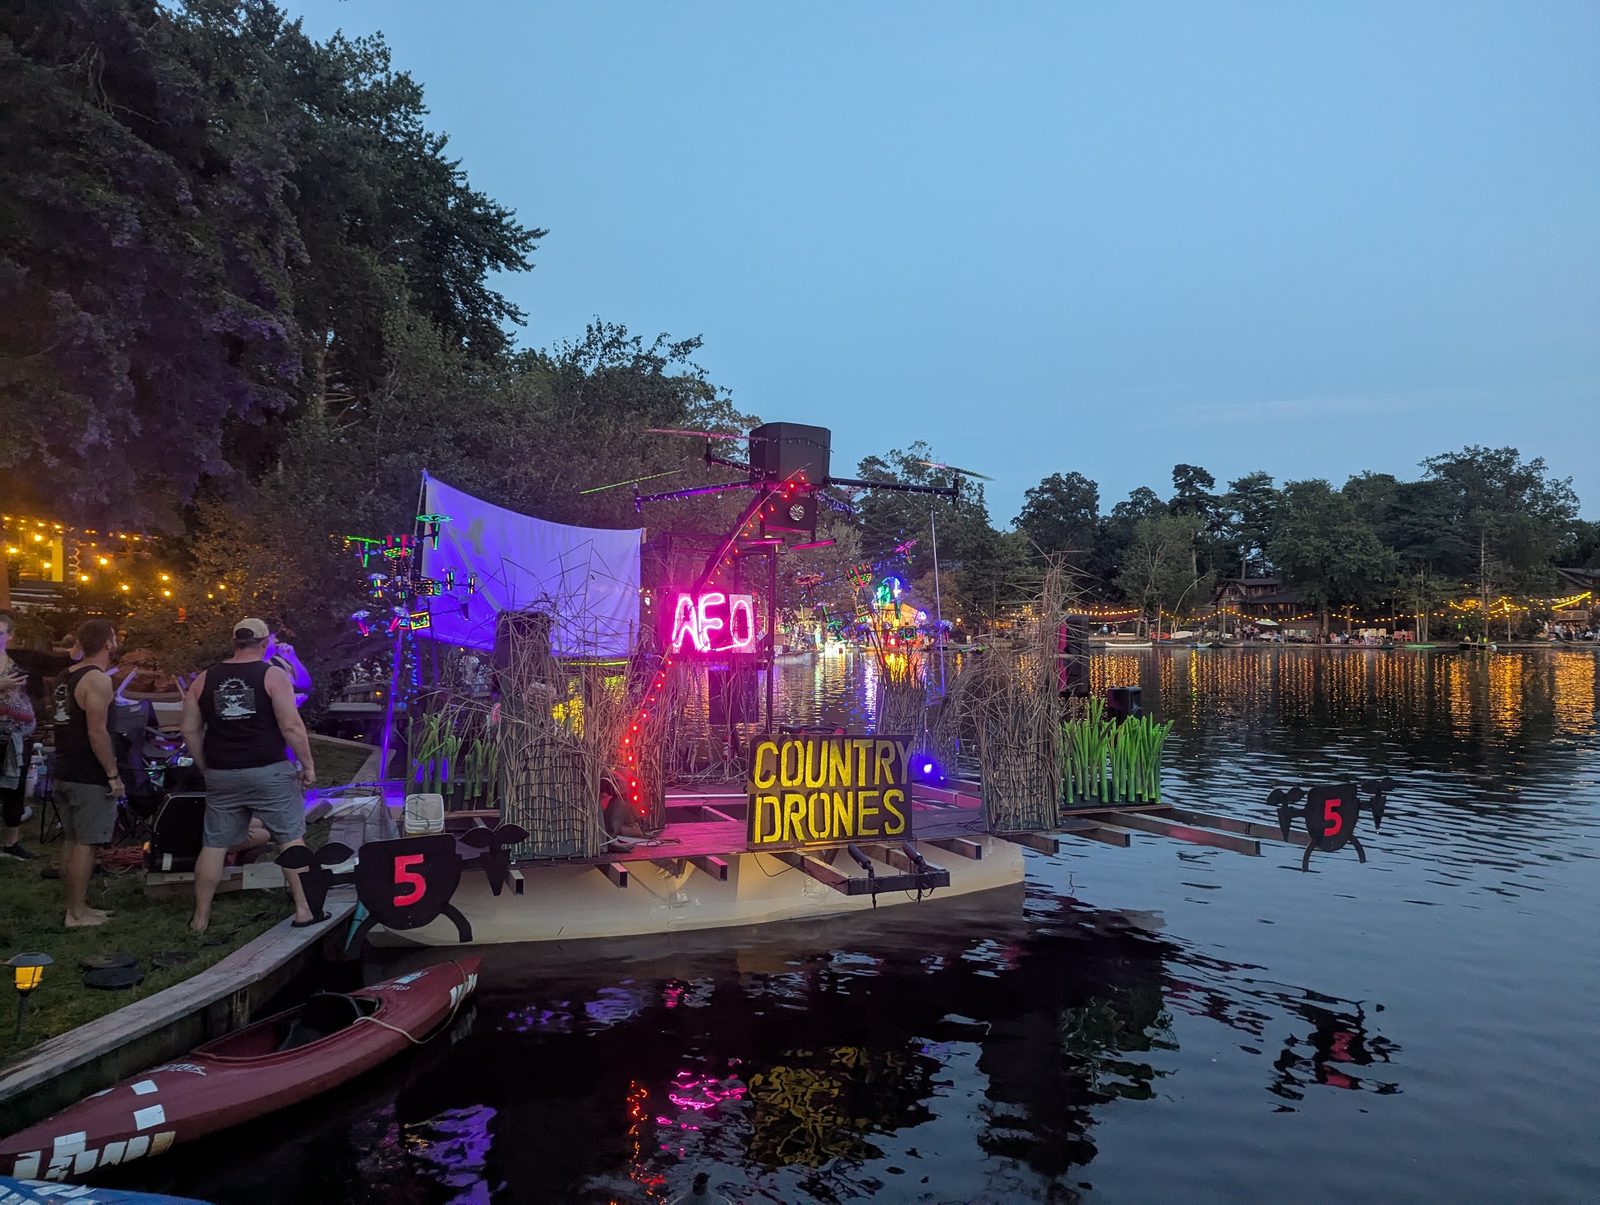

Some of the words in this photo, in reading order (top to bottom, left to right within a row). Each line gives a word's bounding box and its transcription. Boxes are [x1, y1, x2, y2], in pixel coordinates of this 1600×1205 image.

[754, 739, 914, 789] COUNTRY
[754, 789, 905, 844] DRONES
[1324, 798, 1343, 837] 5
[393, 853, 427, 907] 5
